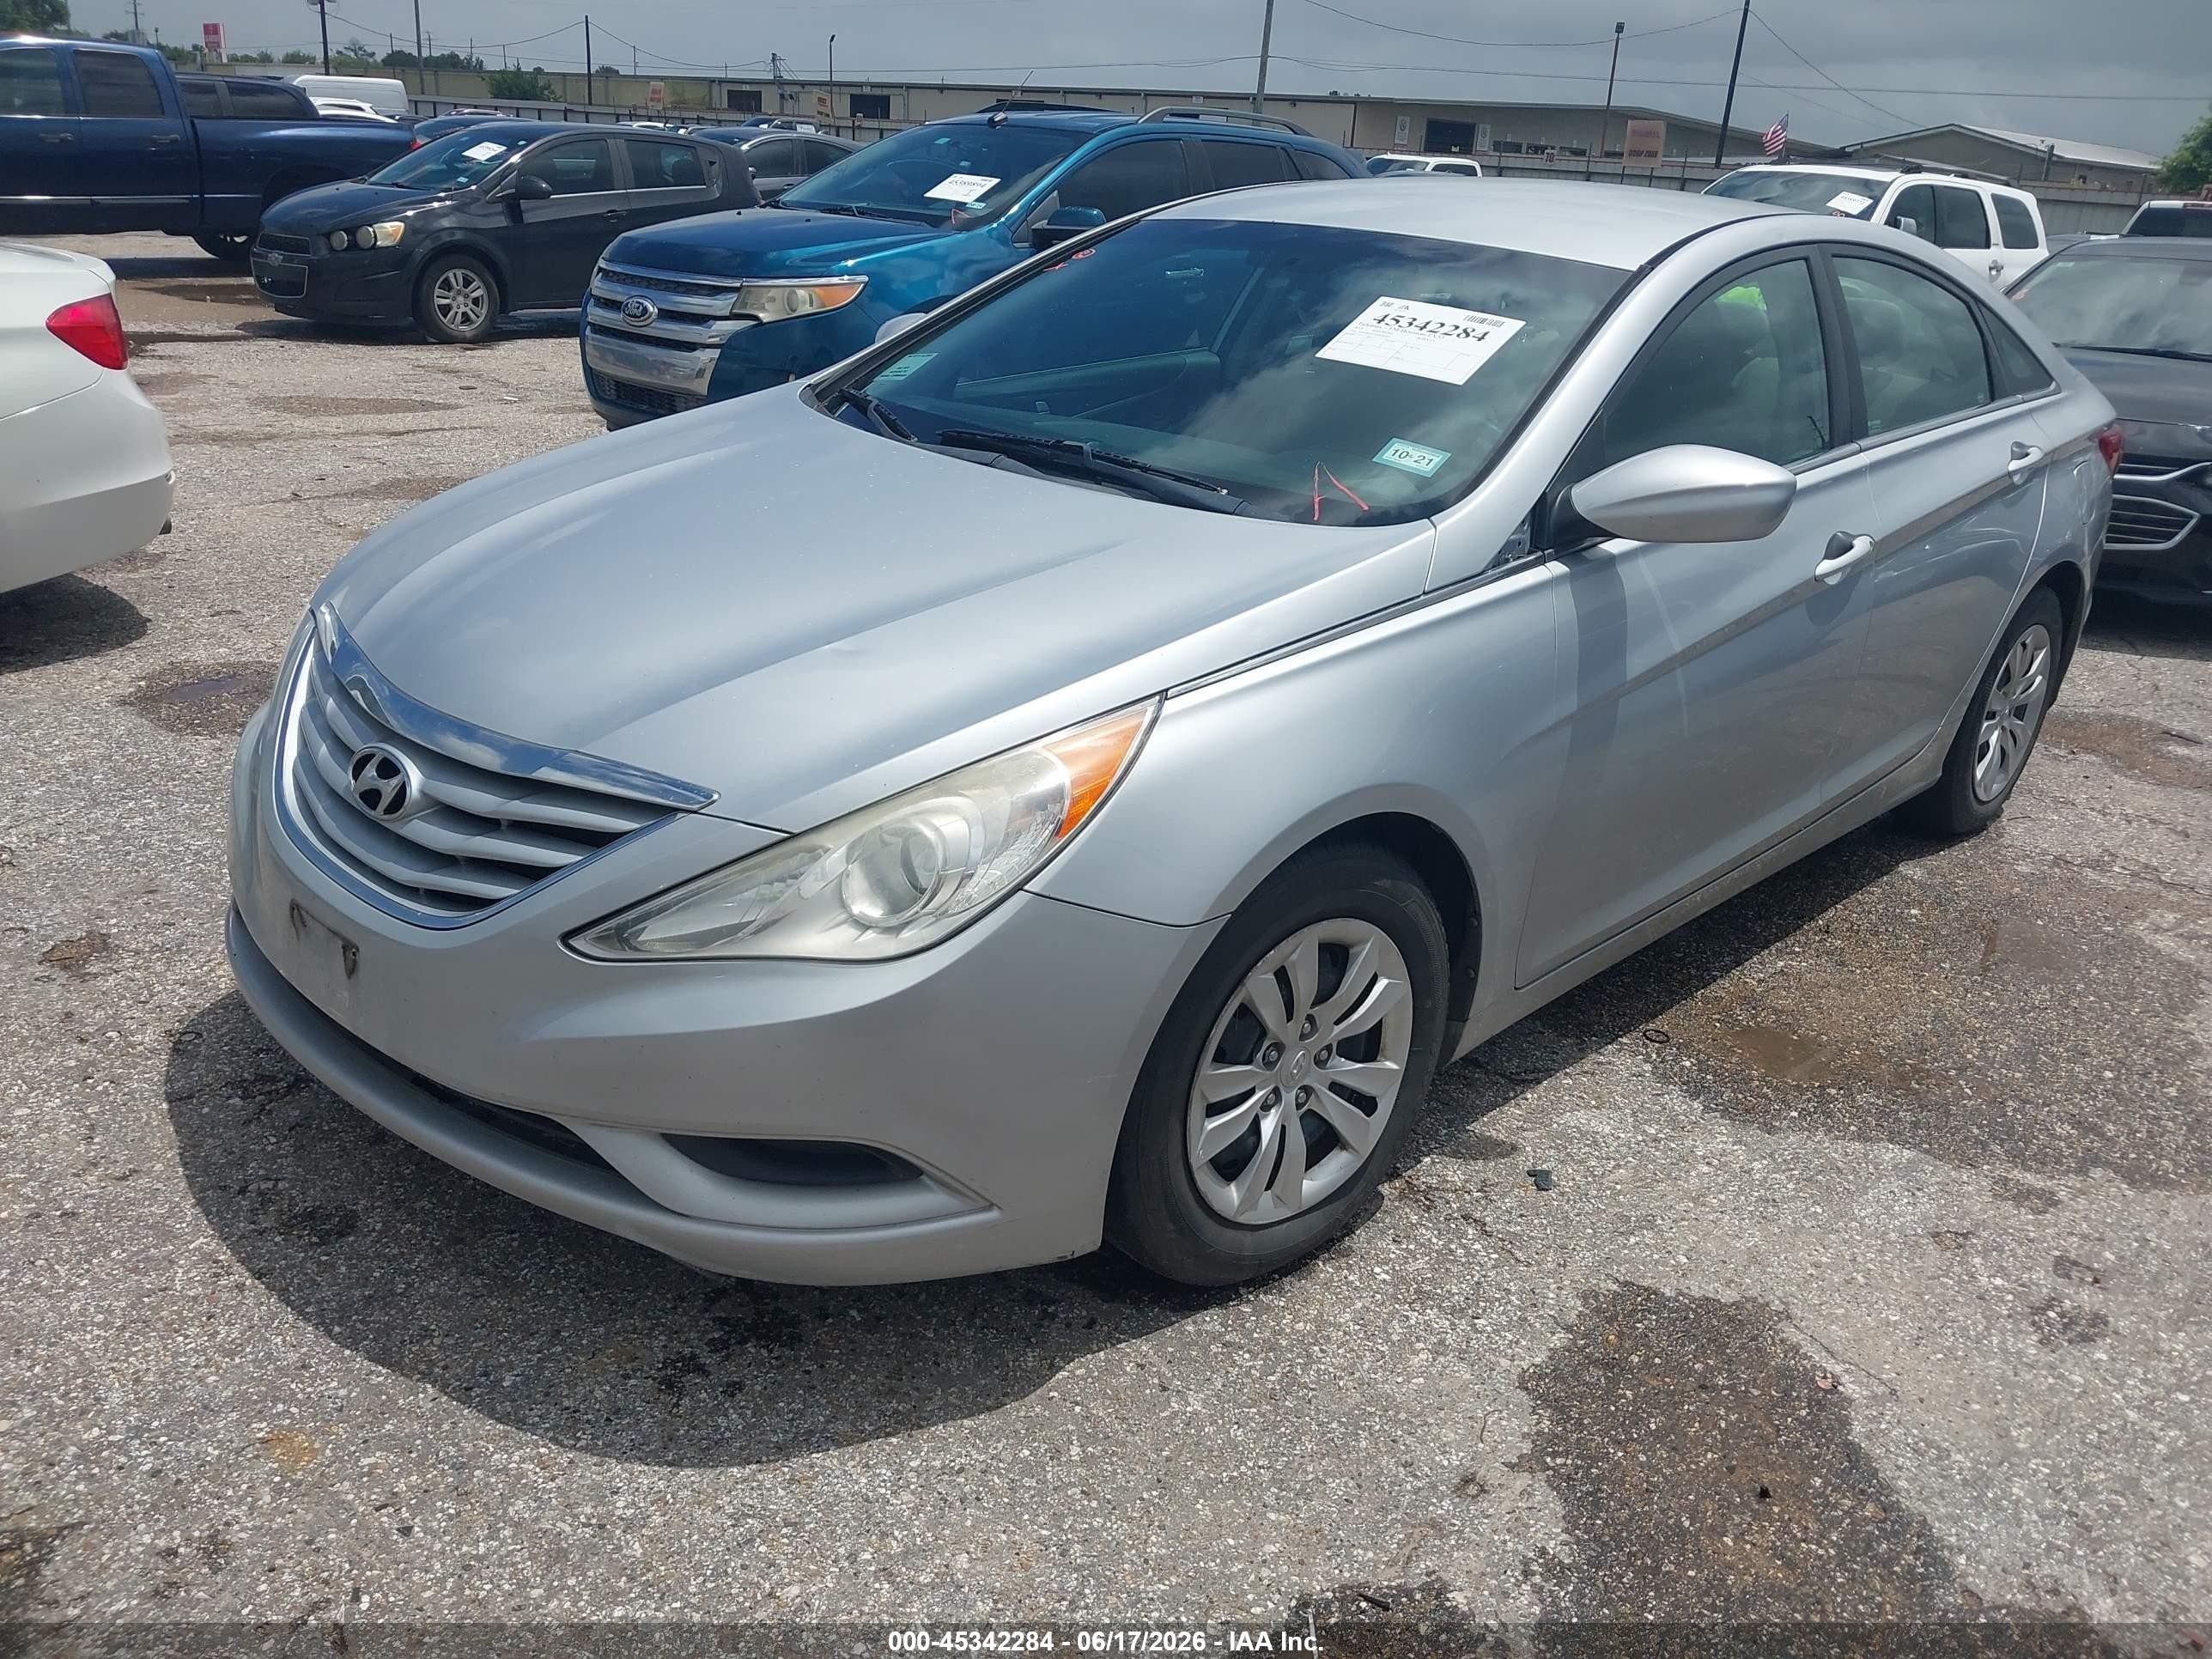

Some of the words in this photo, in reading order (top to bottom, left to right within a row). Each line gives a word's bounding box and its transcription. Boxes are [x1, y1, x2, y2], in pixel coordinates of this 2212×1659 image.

[1372, 313, 1492, 343] 45342284
[1391, 448, 1410, 459] 10
[1413, 454, 1434, 466] 21
